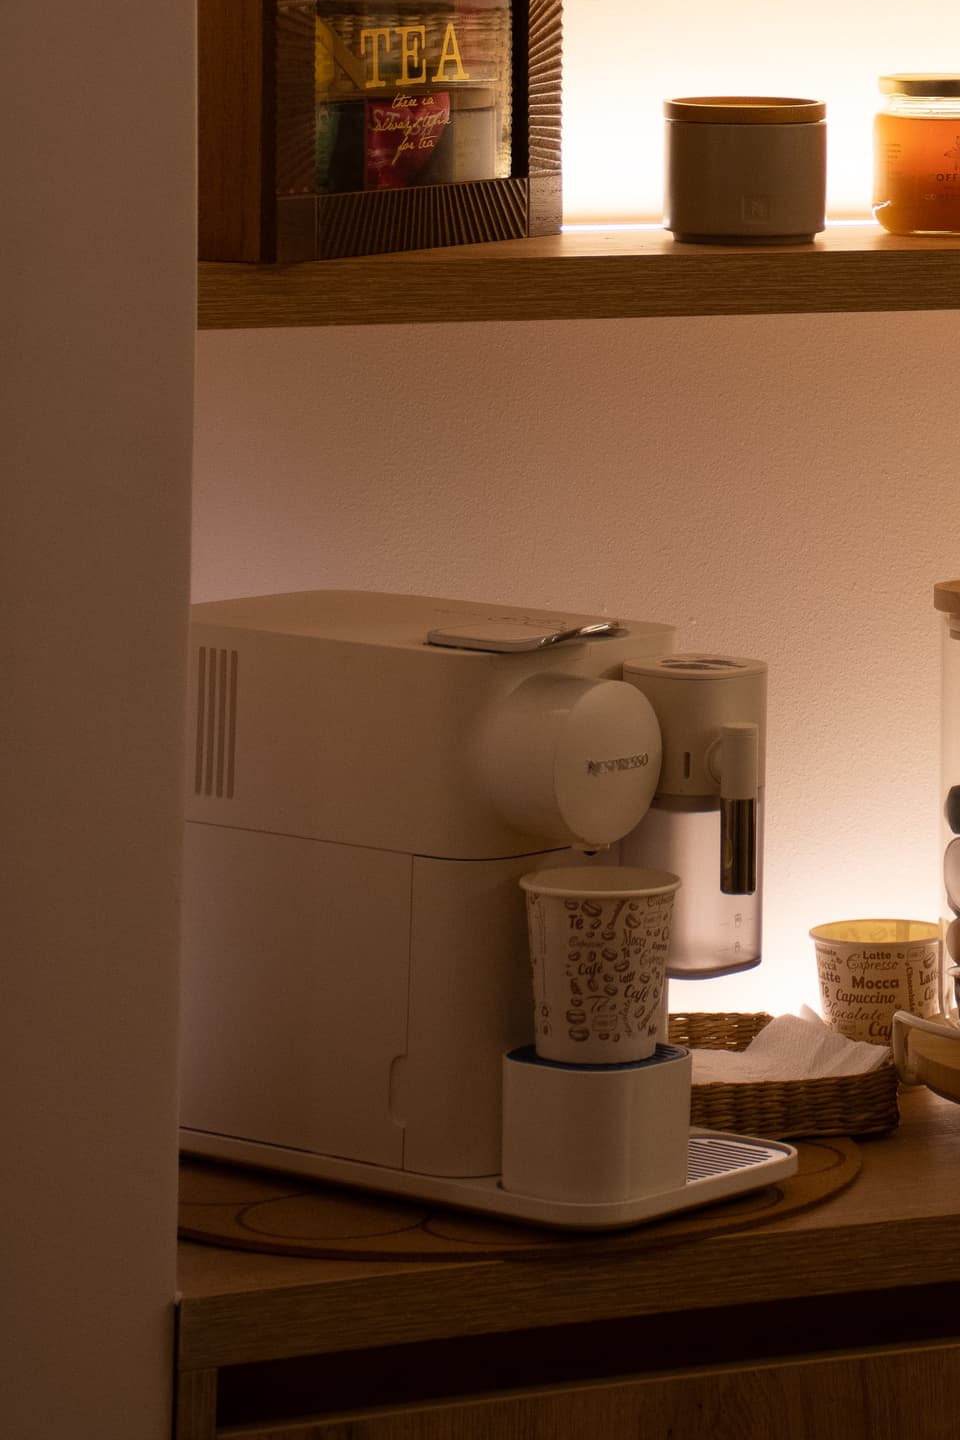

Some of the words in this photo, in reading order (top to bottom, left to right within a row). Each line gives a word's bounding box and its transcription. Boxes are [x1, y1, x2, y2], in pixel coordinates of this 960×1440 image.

[360, 22, 470, 88] TEA
[862, 950, 892, 960] Latte
[578, 962, 604, 979] Café
[851, 975, 900, 989] Mocca
[835, 988, 896, 1006] Capuccino
